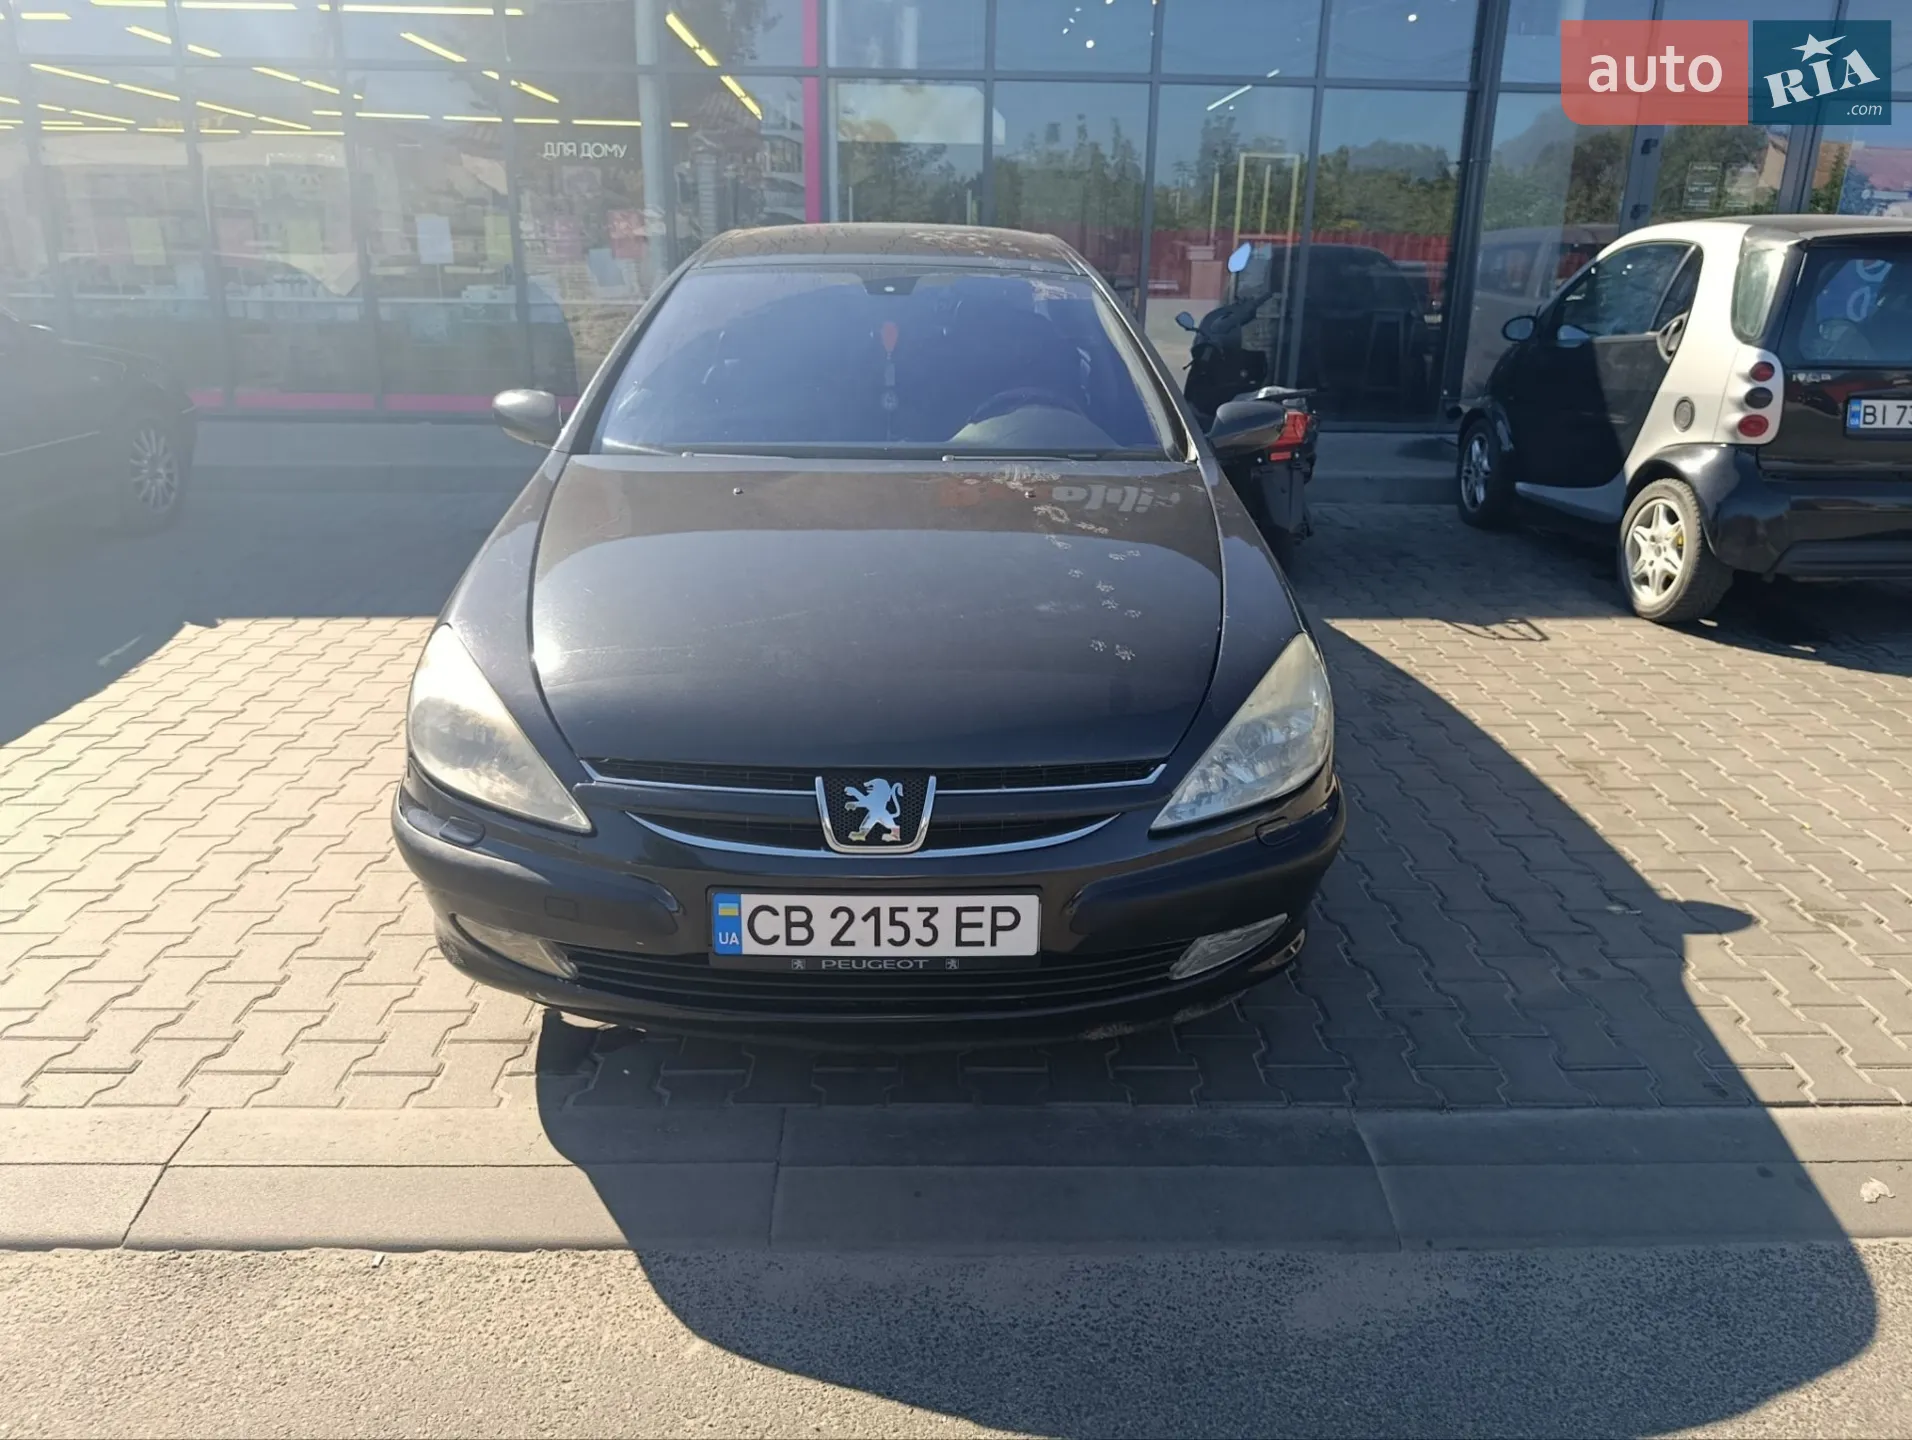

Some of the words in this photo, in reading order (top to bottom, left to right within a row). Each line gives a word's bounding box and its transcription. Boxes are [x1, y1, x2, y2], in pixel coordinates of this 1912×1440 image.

[543, 142, 577, 158] ДЛЯ
[580, 142, 627, 158] ДОМУ
[1862, 404, 1887, 426] BI
[718, 932, 739, 945] UA
[747, 904, 815, 946] CB
[830, 906, 939, 948] 2153
[955, 905, 1021, 947] EP
[821, 959, 929, 970] PEUGEOT
